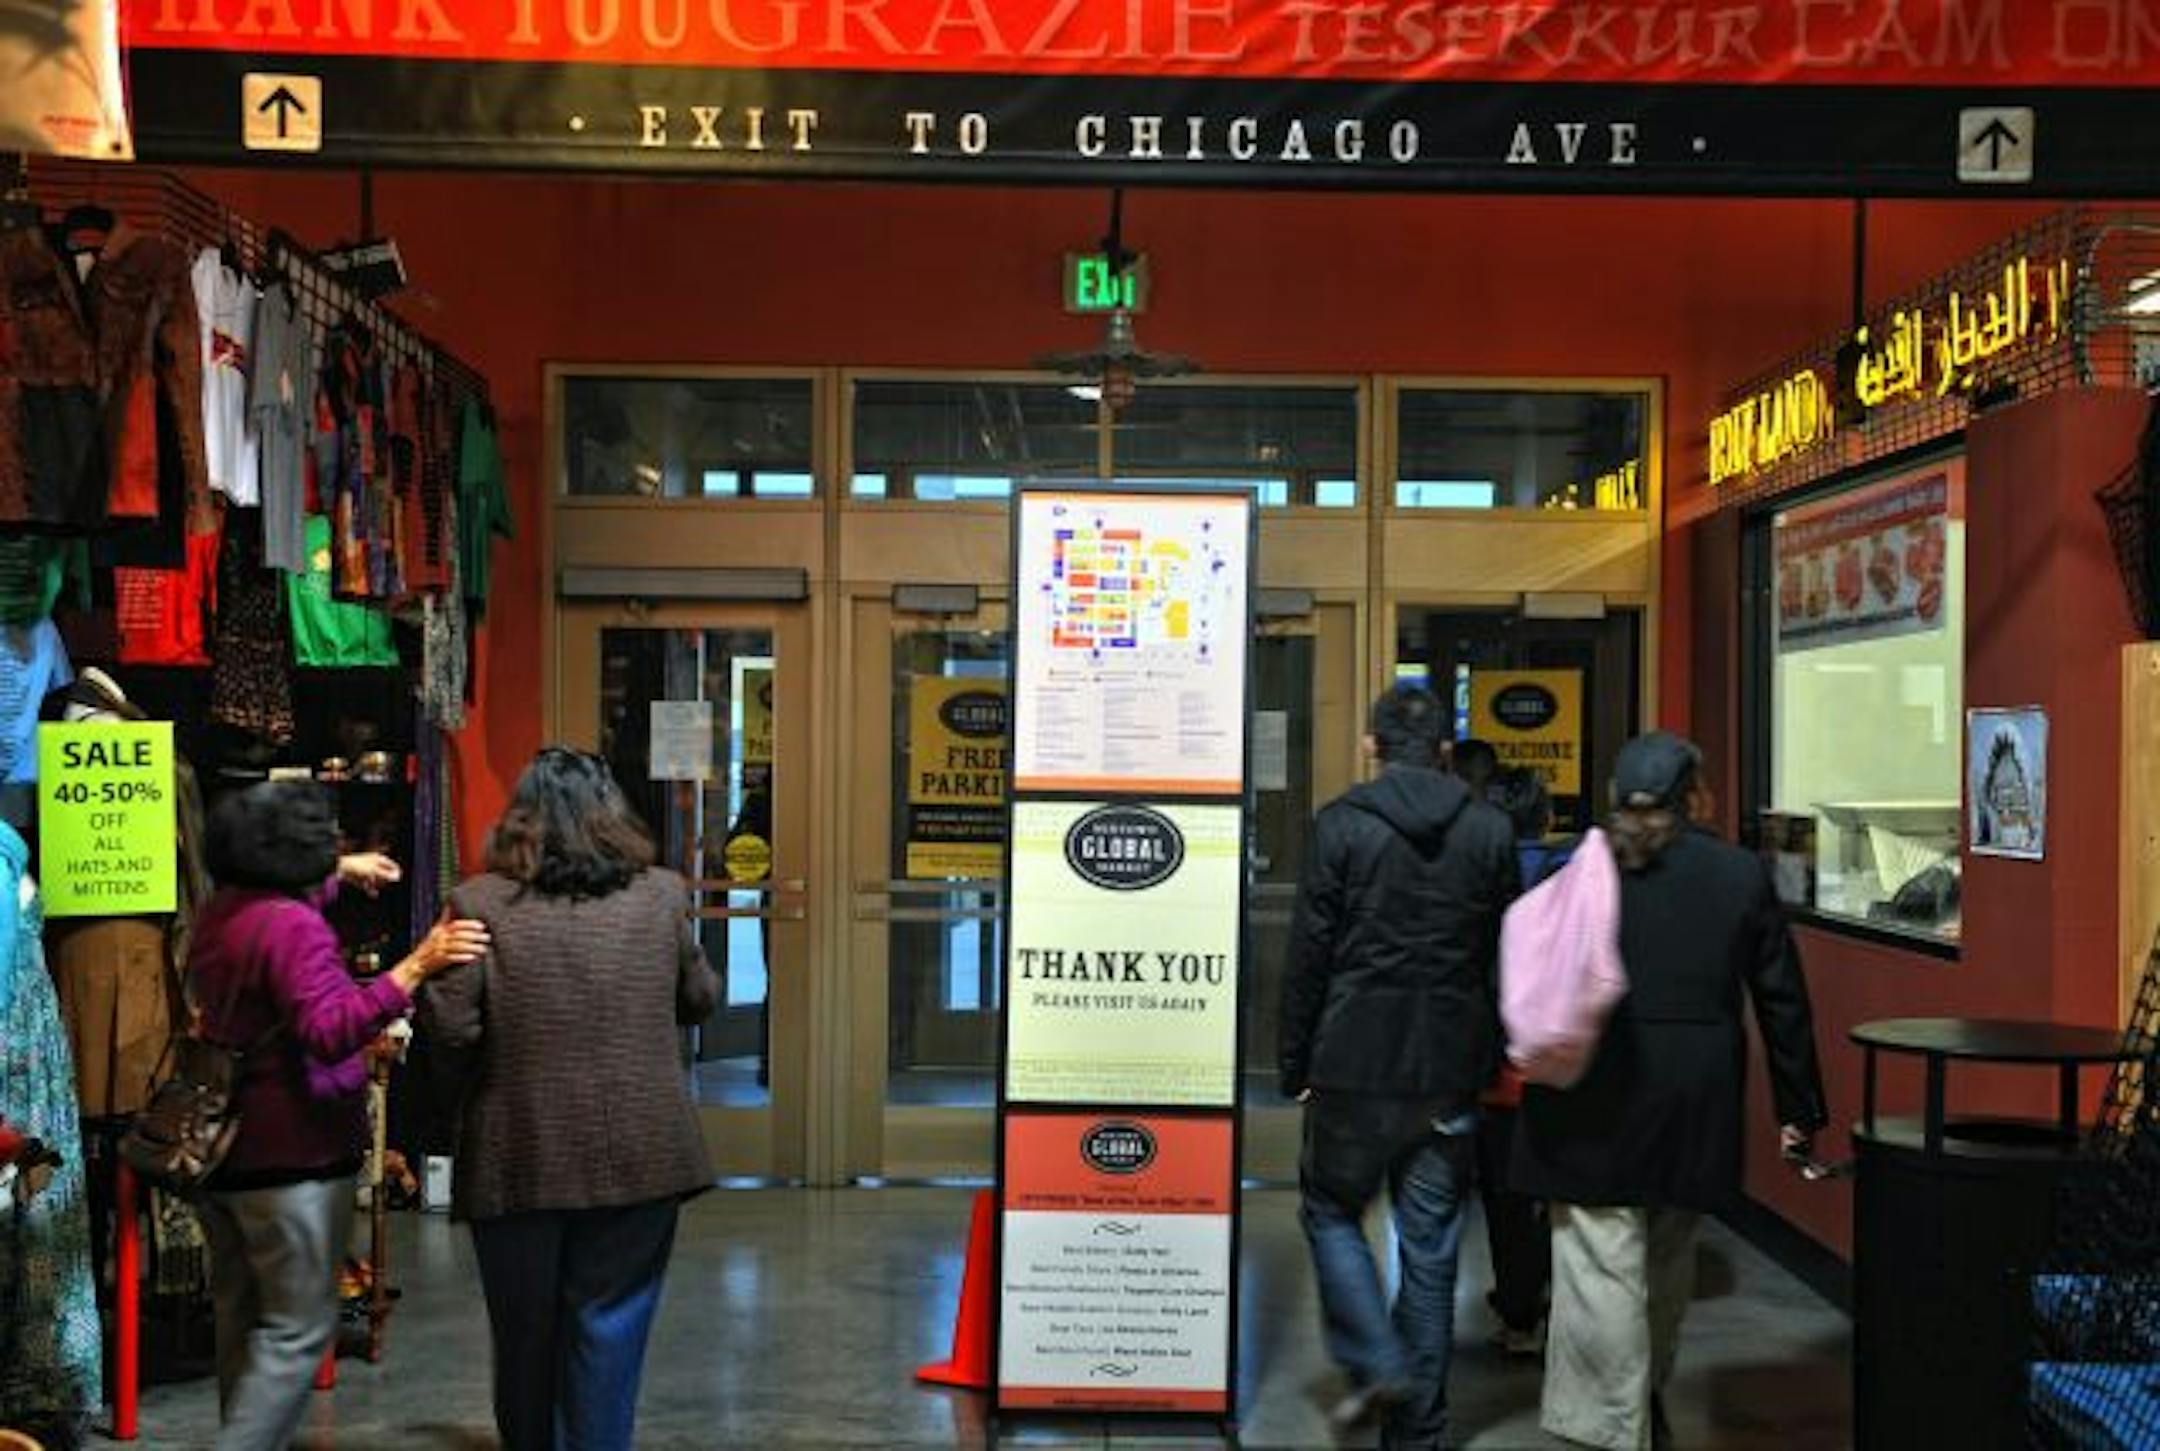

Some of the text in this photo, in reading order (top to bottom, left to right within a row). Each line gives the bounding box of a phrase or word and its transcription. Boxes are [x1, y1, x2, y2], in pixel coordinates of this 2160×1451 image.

[640, 106, 1638, 165] EXIT TO CHICAGO AVE
[63, 741, 152, 768] SALE
[54, 781, 162, 804] 40-50%
[90, 813, 126, 830] OFF
[94, 836, 125, 851] ALL
[1081, 835, 1166, 862] GLOBAL
[67, 857, 152, 875] HATS AND
[73, 880, 149, 896] MITTENS
[1017, 949, 1227, 985] THANK YOU
